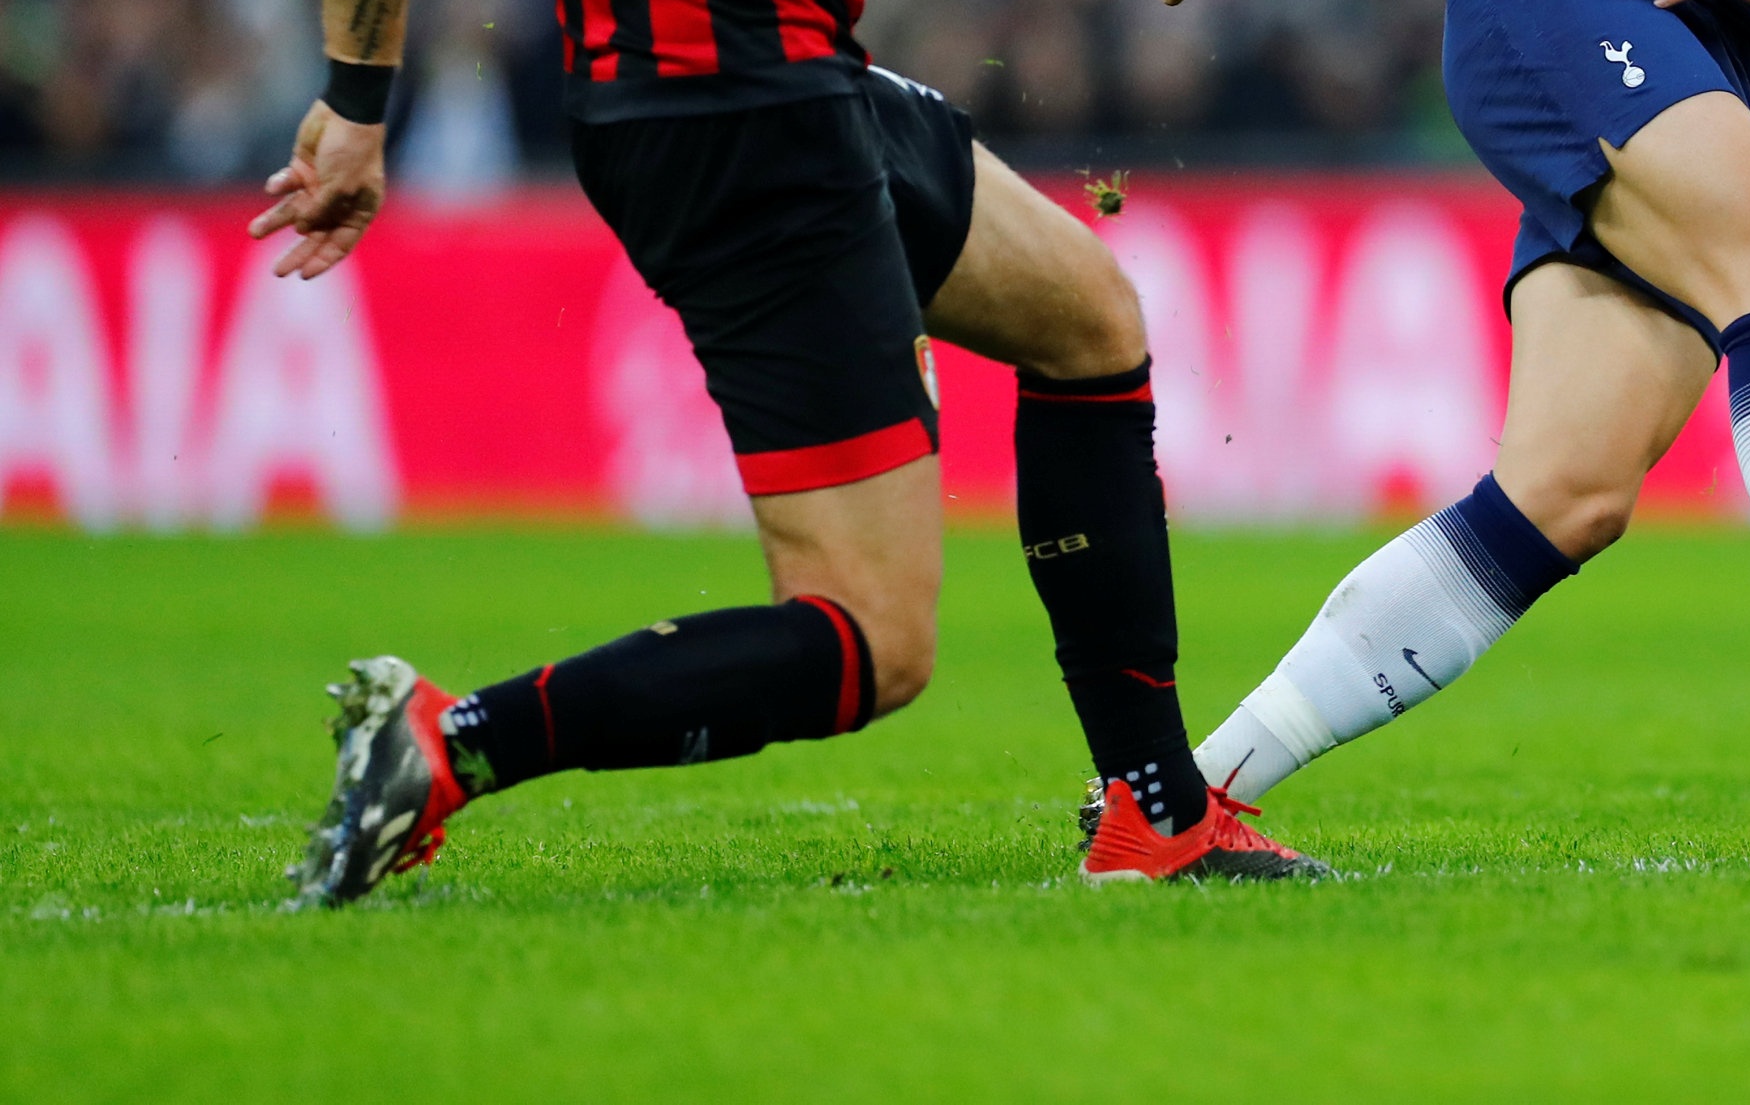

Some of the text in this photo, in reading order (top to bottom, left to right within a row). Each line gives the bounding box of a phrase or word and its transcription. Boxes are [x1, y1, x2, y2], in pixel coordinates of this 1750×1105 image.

[0, 206, 398, 536] AIA
[1023, 533, 1089, 563] FCB
[1373, 672, 1406, 718] SPUR
